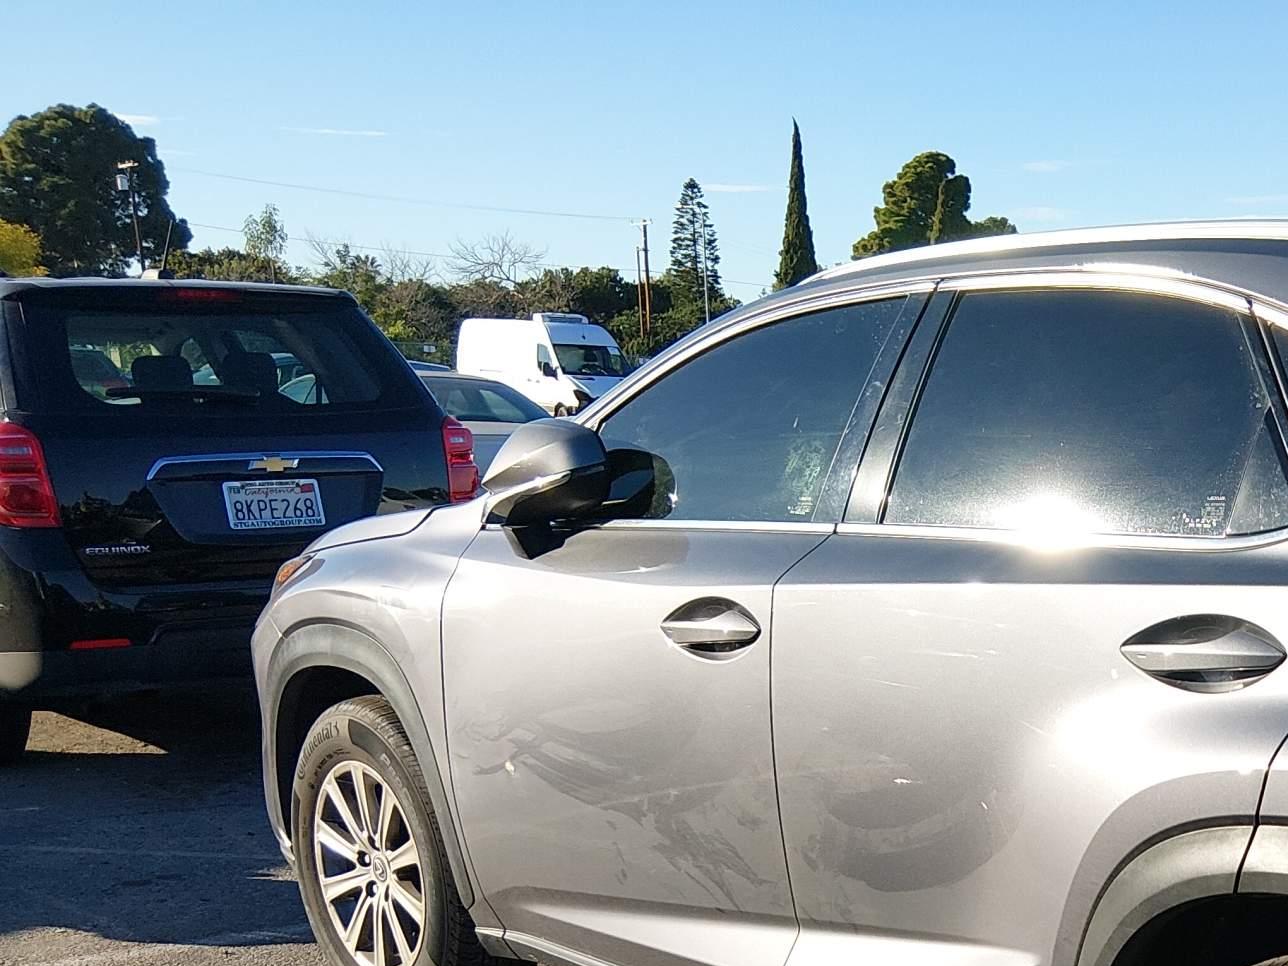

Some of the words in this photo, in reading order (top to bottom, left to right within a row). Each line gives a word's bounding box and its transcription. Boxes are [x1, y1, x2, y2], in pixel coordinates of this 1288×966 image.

[233, 498, 316, 521] 8KPE268
[233, 518, 322, 528] STGAUTOGROUP.COM
[85, 545, 152, 556] EQUINOX
